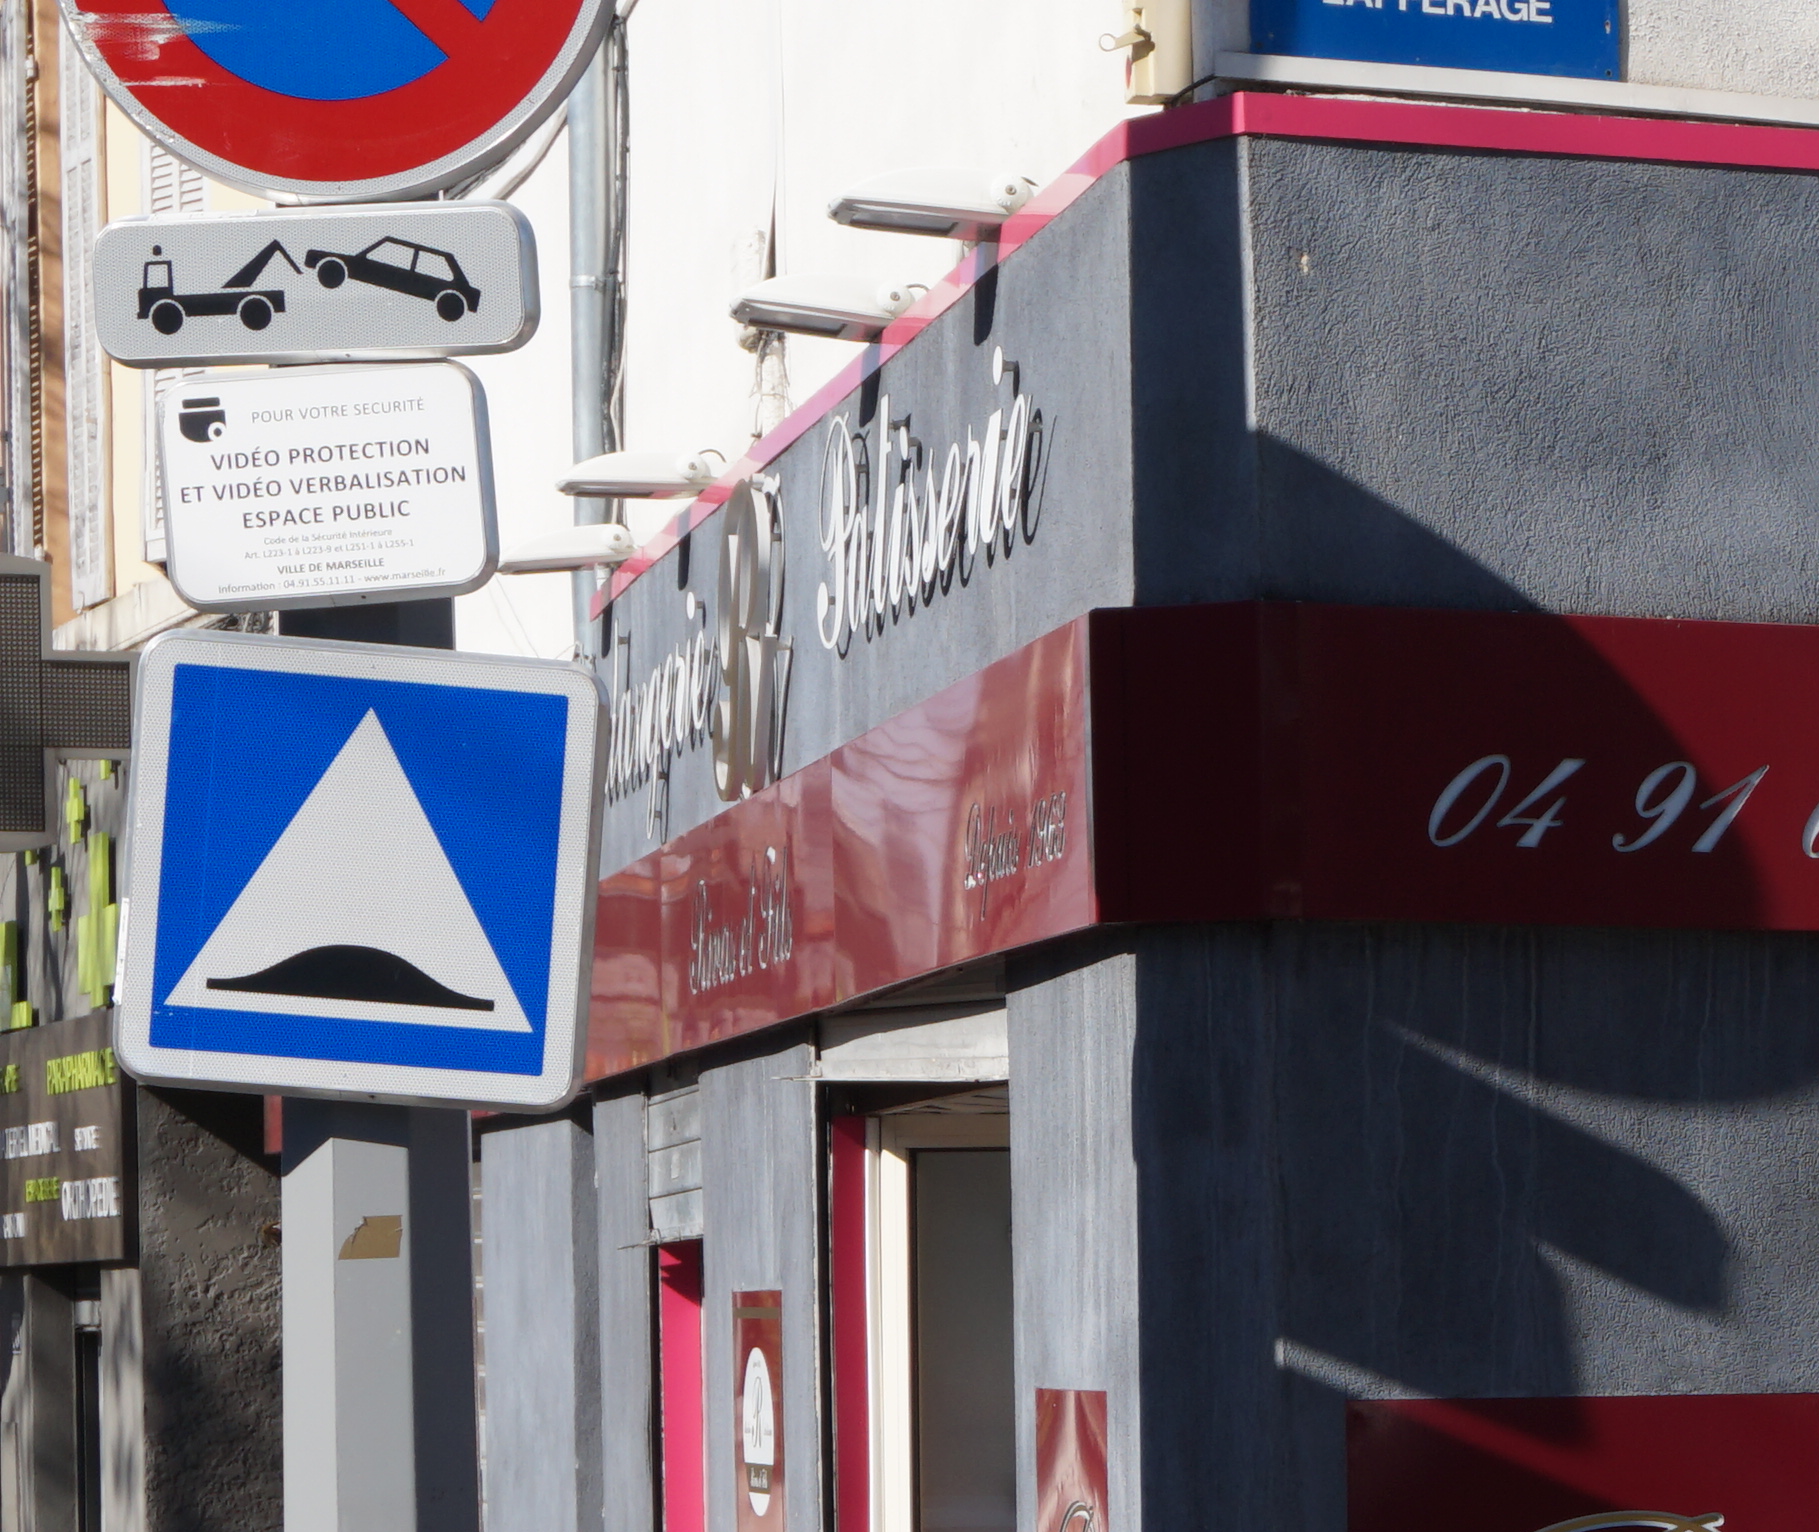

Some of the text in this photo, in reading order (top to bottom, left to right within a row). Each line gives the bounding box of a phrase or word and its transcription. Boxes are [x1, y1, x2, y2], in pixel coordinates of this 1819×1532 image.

[251, 409, 294, 423] POUR
[299, 405, 348, 420] VOTRE
[210, 438, 430, 471] VIDÉO PROTECTION
[180, 466, 467, 504] ET VIDÉO VERBALISATION
[243, 500, 411, 529] ESPACE PUBLIC
[263, 535, 286, 546] Code
[288, 534, 300, 544] de
[311, 530, 348, 542] Sécurité
[349, 528, 393, 539] Intérieure
[277, 557, 385, 574] VILLE DE MARSEILLE
[218, 581, 276, 594] Information
[1427, 754, 1586, 848] 04
[1612, 761, 1770, 854] 91
